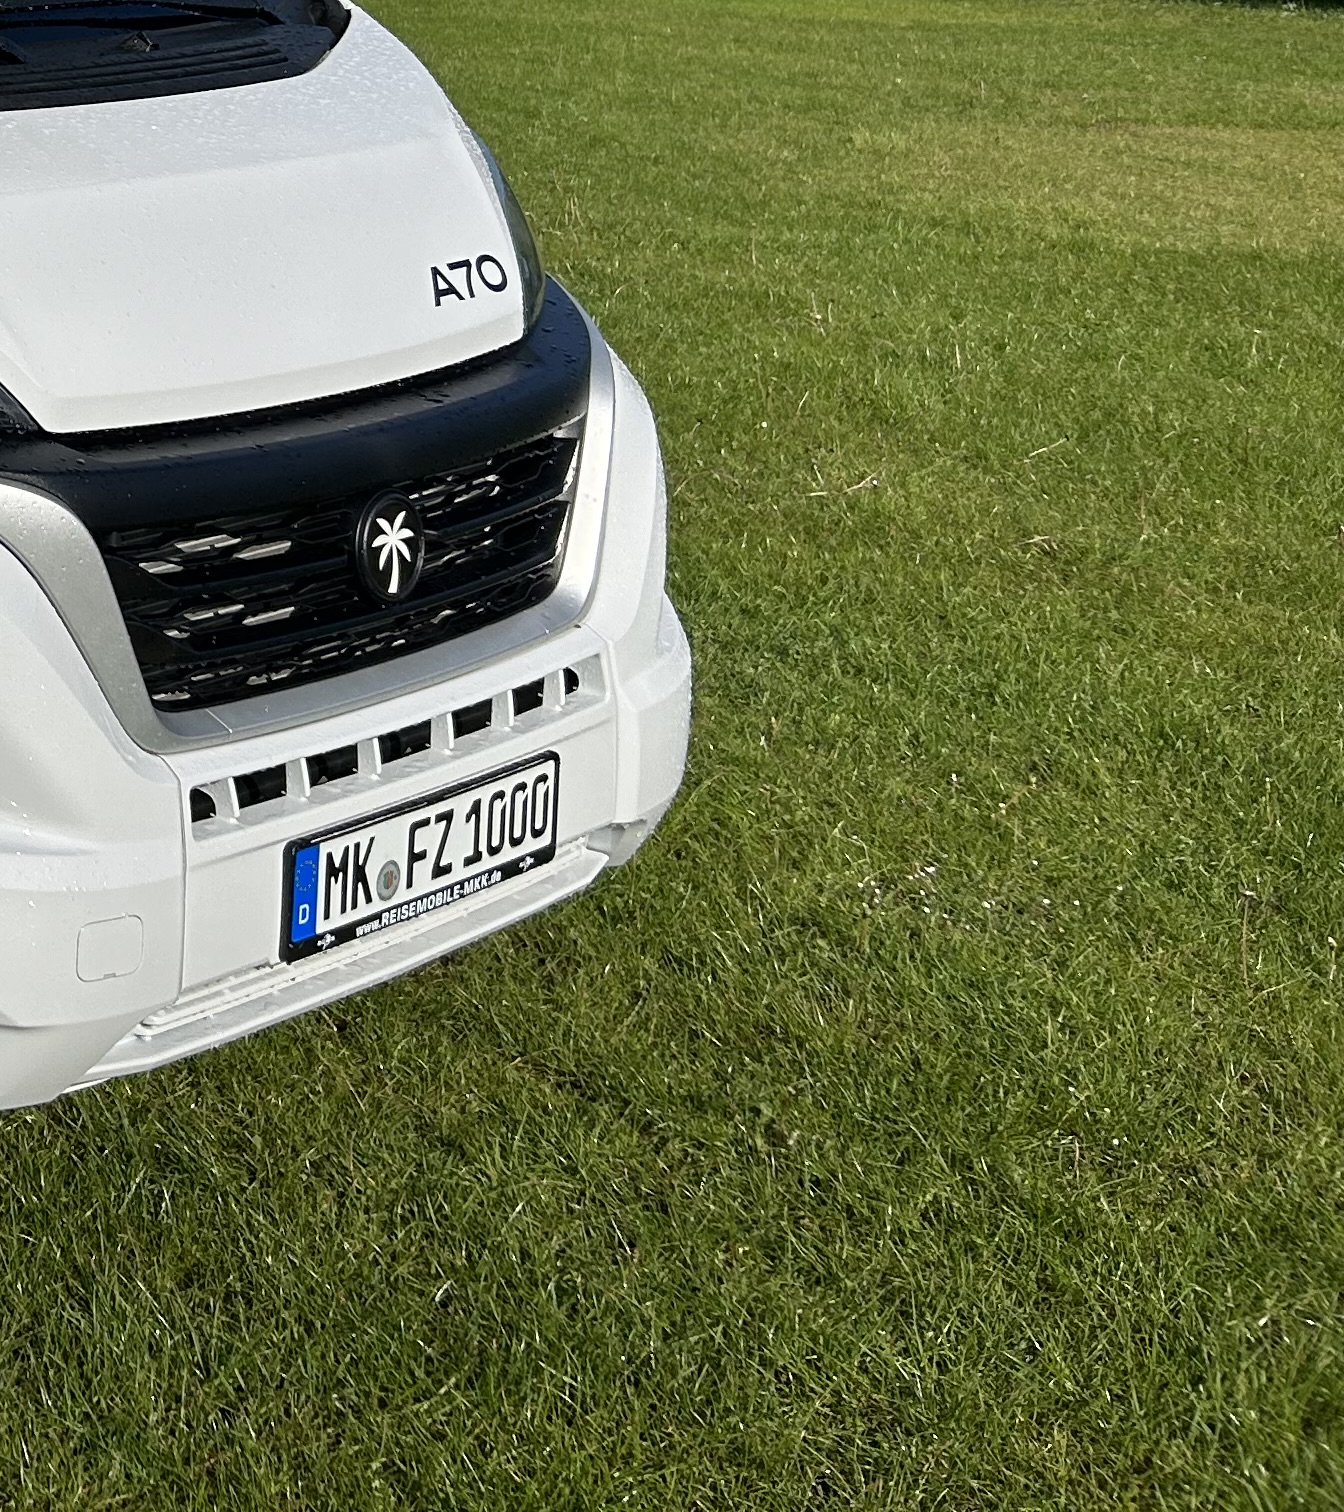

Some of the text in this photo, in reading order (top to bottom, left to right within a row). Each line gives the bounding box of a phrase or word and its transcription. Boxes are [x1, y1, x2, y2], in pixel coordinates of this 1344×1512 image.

[430, 254, 508, 307] A70
[323, 836, 375, 921] MK
[298, 903, 310, 925] D
